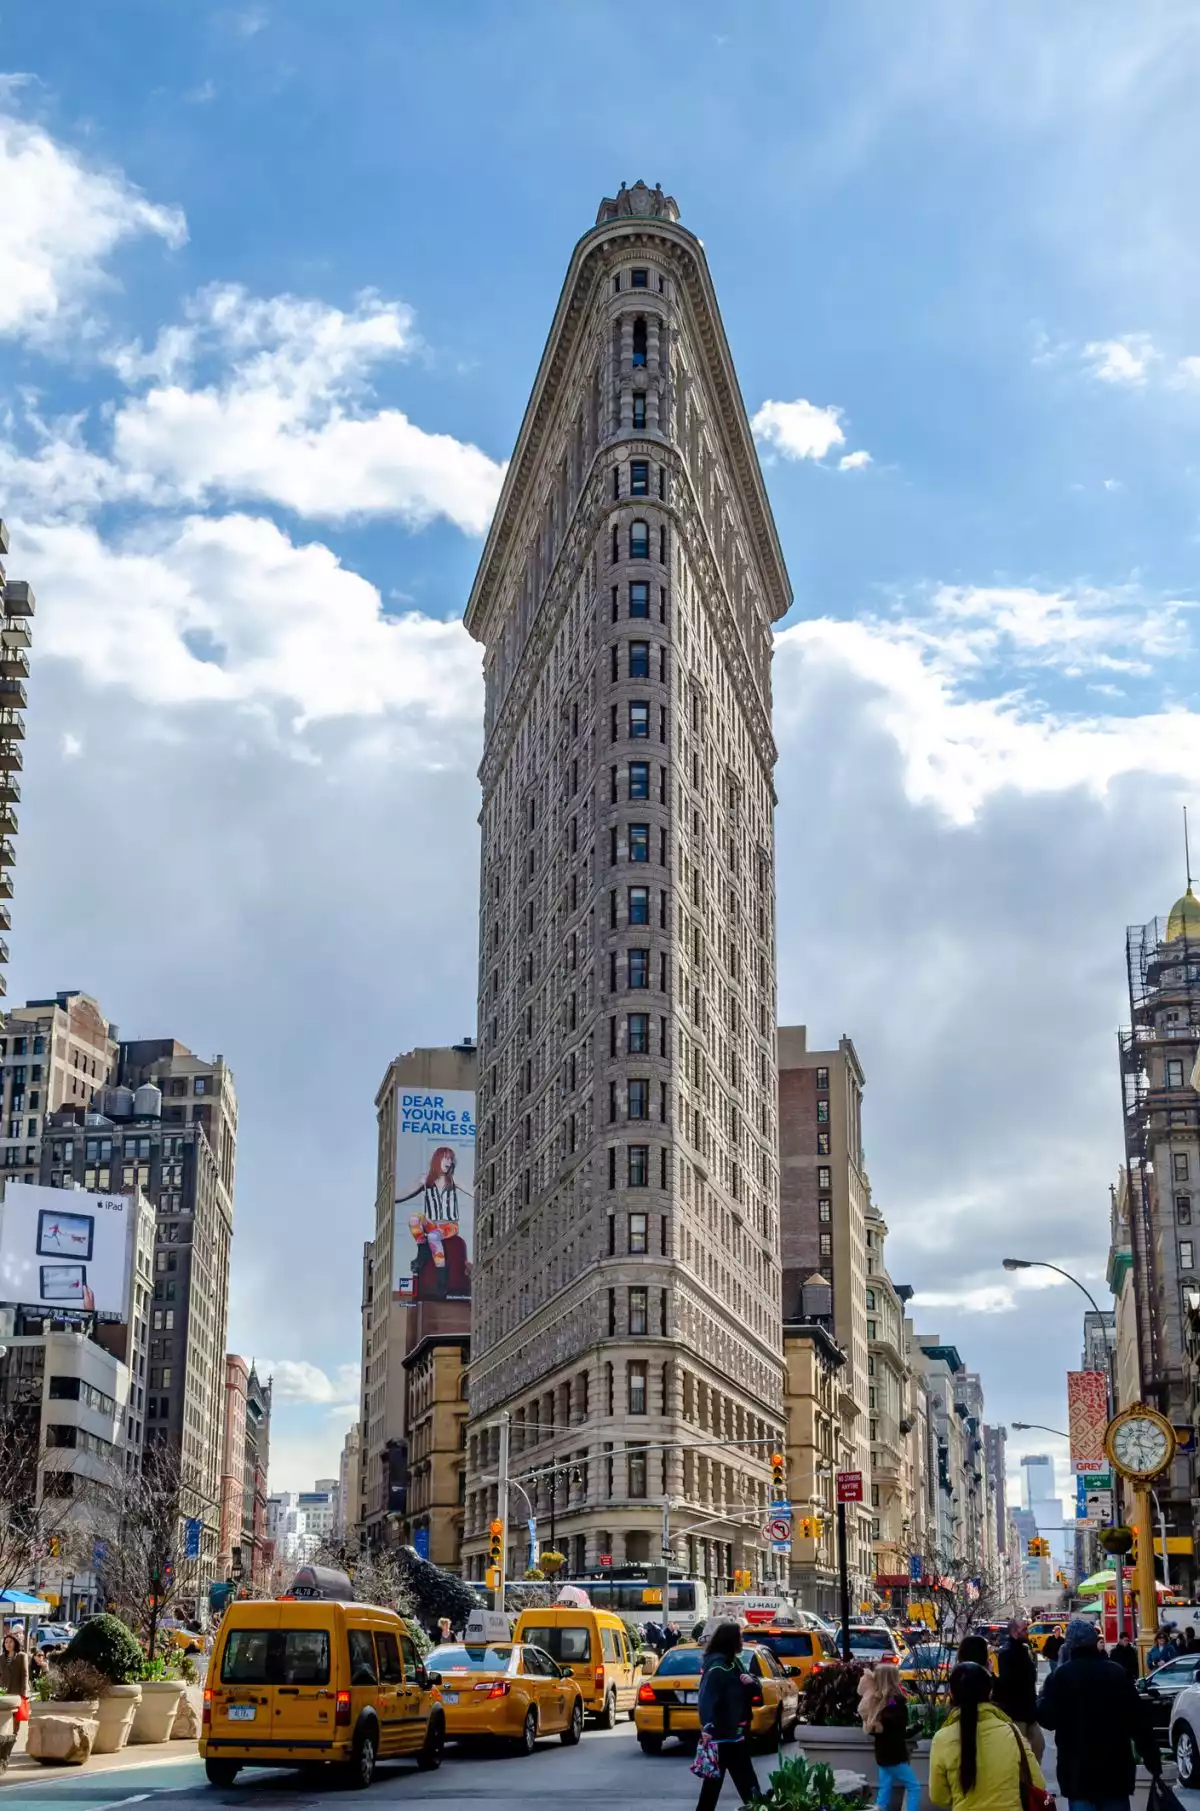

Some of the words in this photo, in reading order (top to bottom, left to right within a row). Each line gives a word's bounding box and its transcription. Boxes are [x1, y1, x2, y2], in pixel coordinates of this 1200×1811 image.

[403, 1095, 444, 1107] DEAR
[402, 1108, 456, 1121] YOUNG
[462, 1111, 471, 1122] &
[402, 1121, 476, 1135] FEARLESS
[105, 1201, 123, 1211] iPad
[1076, 1462, 1103, 1471] GREY
